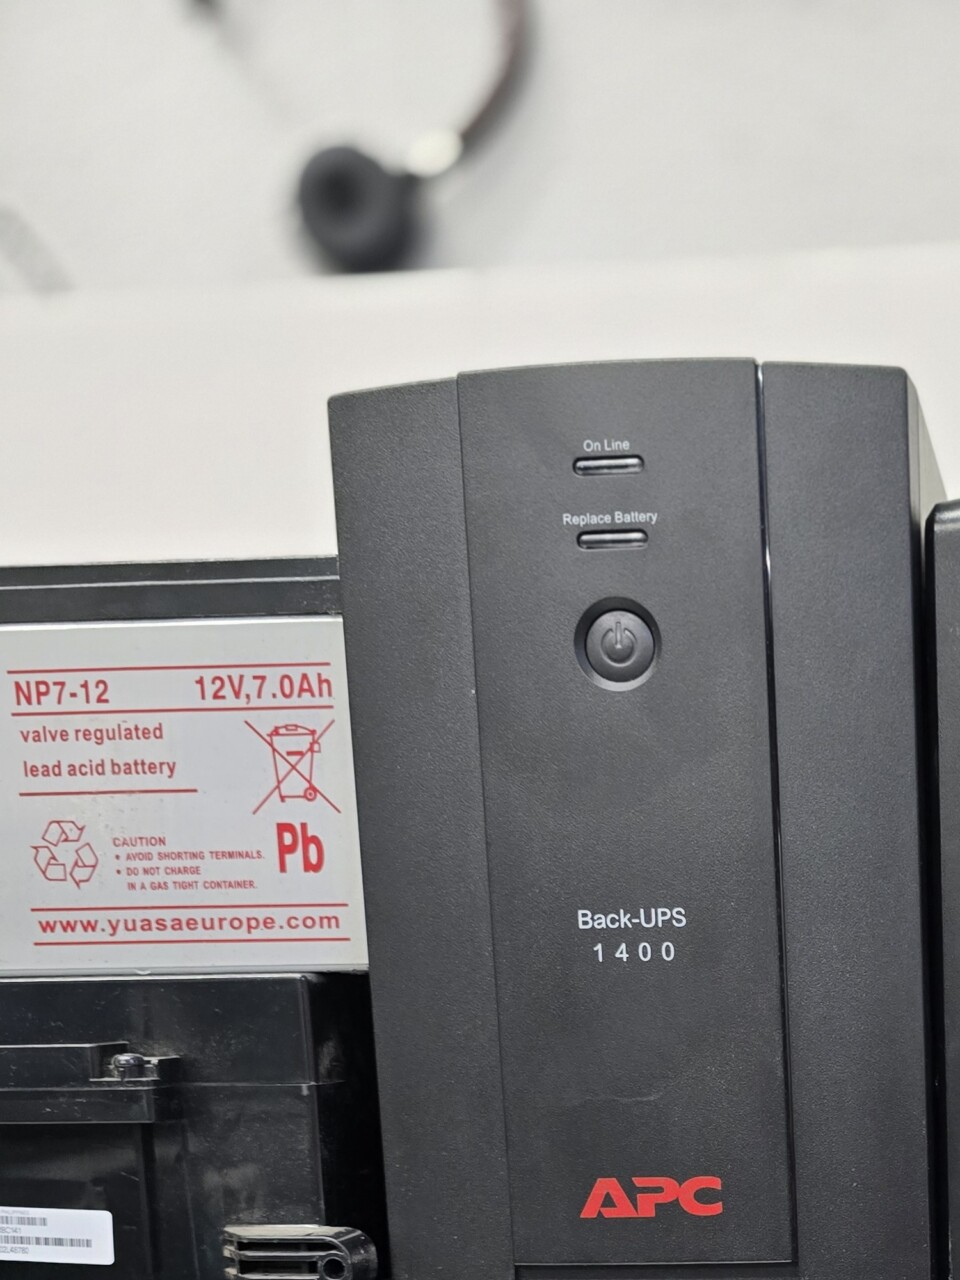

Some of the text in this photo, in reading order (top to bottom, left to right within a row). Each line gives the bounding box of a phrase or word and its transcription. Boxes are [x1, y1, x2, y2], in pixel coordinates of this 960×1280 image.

[583, 439, 630, 451] On Line
[563, 511, 658, 526] Replace Battery
[14, 680, 110, 706] NP7-12
[195, 673, 333, 705] 12V,7.0Ah
[20, 723, 164, 746] valve regulated
[23, 759, 177, 779] lead acid battery
[113, 836, 167, 848] CAUTION
[276, 822, 325, 874] Pb
[126, 850, 265, 861] AVOID SHORTING TERMINALS.
[126, 866, 201, 876] DO NOT CHARGE
[127, 880, 258, 890] IN A GAS TIGHT CONTAINER.
[38, 914, 341, 936] www.yuasaeurope.com
[577, 907, 687, 929] Back-UPS
[593, 942, 675, 962] 1400
[579, 1176, 723, 1218] APC
